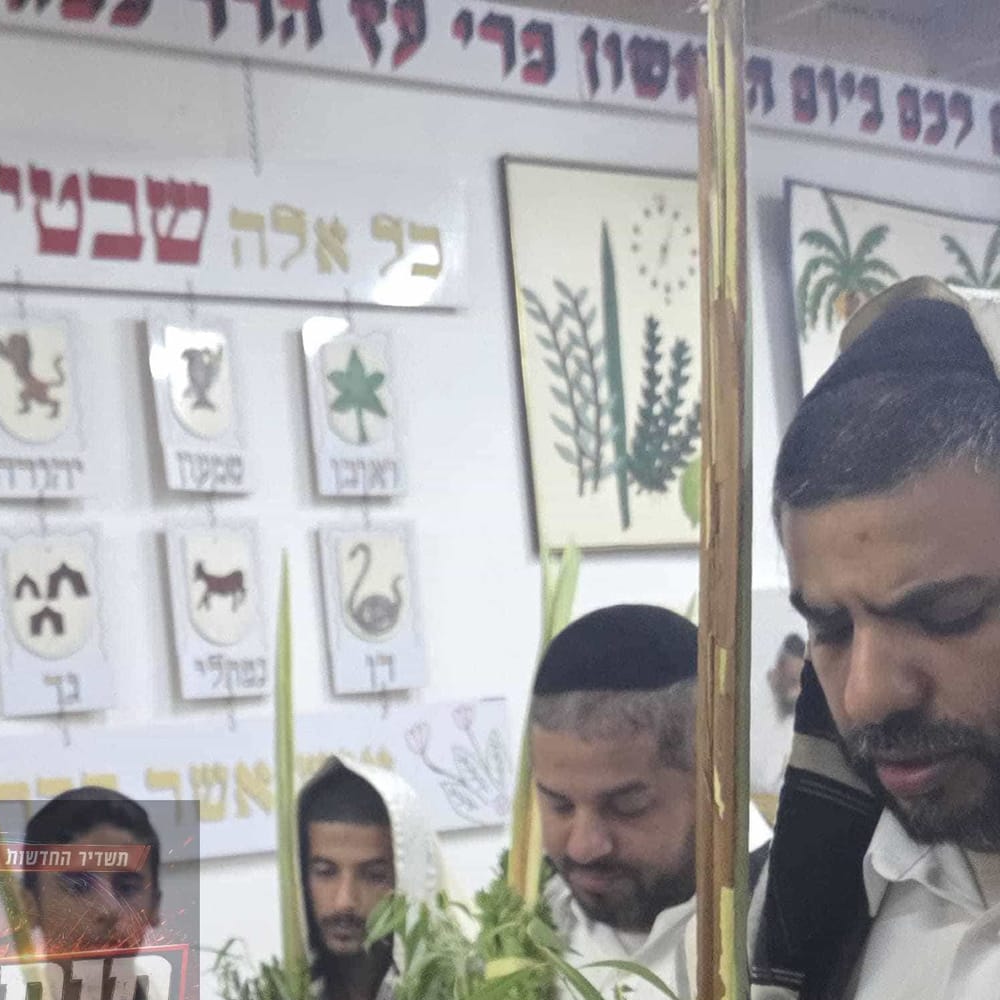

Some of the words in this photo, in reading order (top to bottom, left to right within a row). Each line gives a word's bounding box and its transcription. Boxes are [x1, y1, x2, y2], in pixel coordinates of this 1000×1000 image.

[452, 9, 556, 86] פרי
[580, 25, 775, 118] האשון
[789, 65, 884, 134] ביום
[896, 83, 974, 149] לכם
[229, 202, 351, 275] אלה
[370, 205, 445, 280] כל
[364, 653, 397, 689] דן
